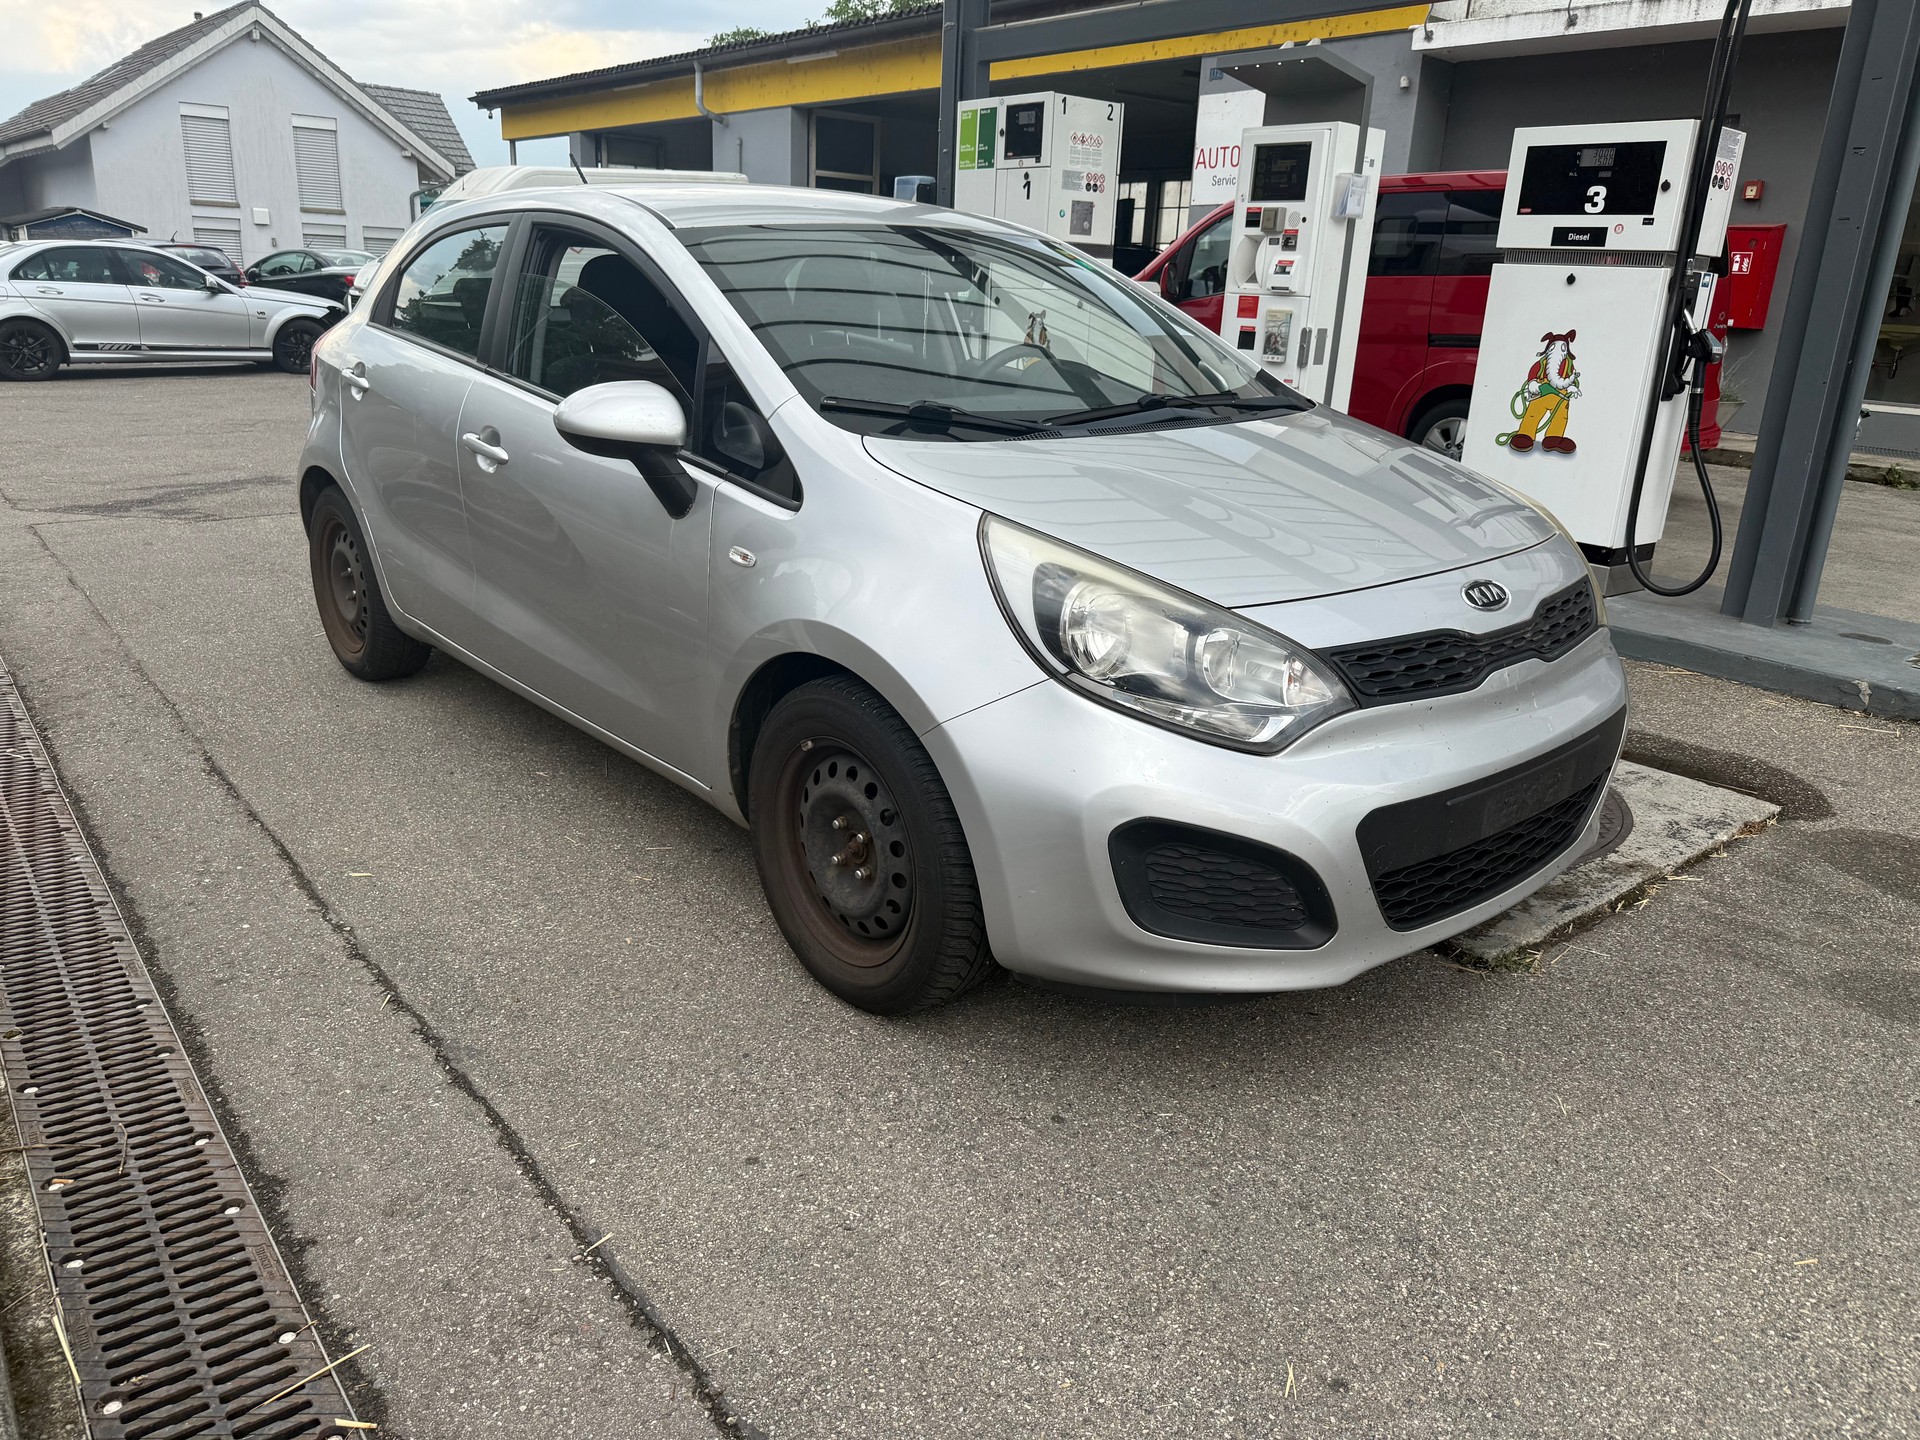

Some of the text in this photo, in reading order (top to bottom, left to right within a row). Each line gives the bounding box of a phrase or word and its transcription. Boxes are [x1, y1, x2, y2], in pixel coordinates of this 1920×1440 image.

[1061, 96, 1114, 121] 1 2
[1195, 145, 1241, 170] AUTO
[1022, 180, 1031, 200] 1
[1211, 174, 1237, 187] Servic
[1584, 185, 1607, 214] 3
[1567, 233, 1590, 241] Diesel
[1467, 584, 1506, 606] KIA
